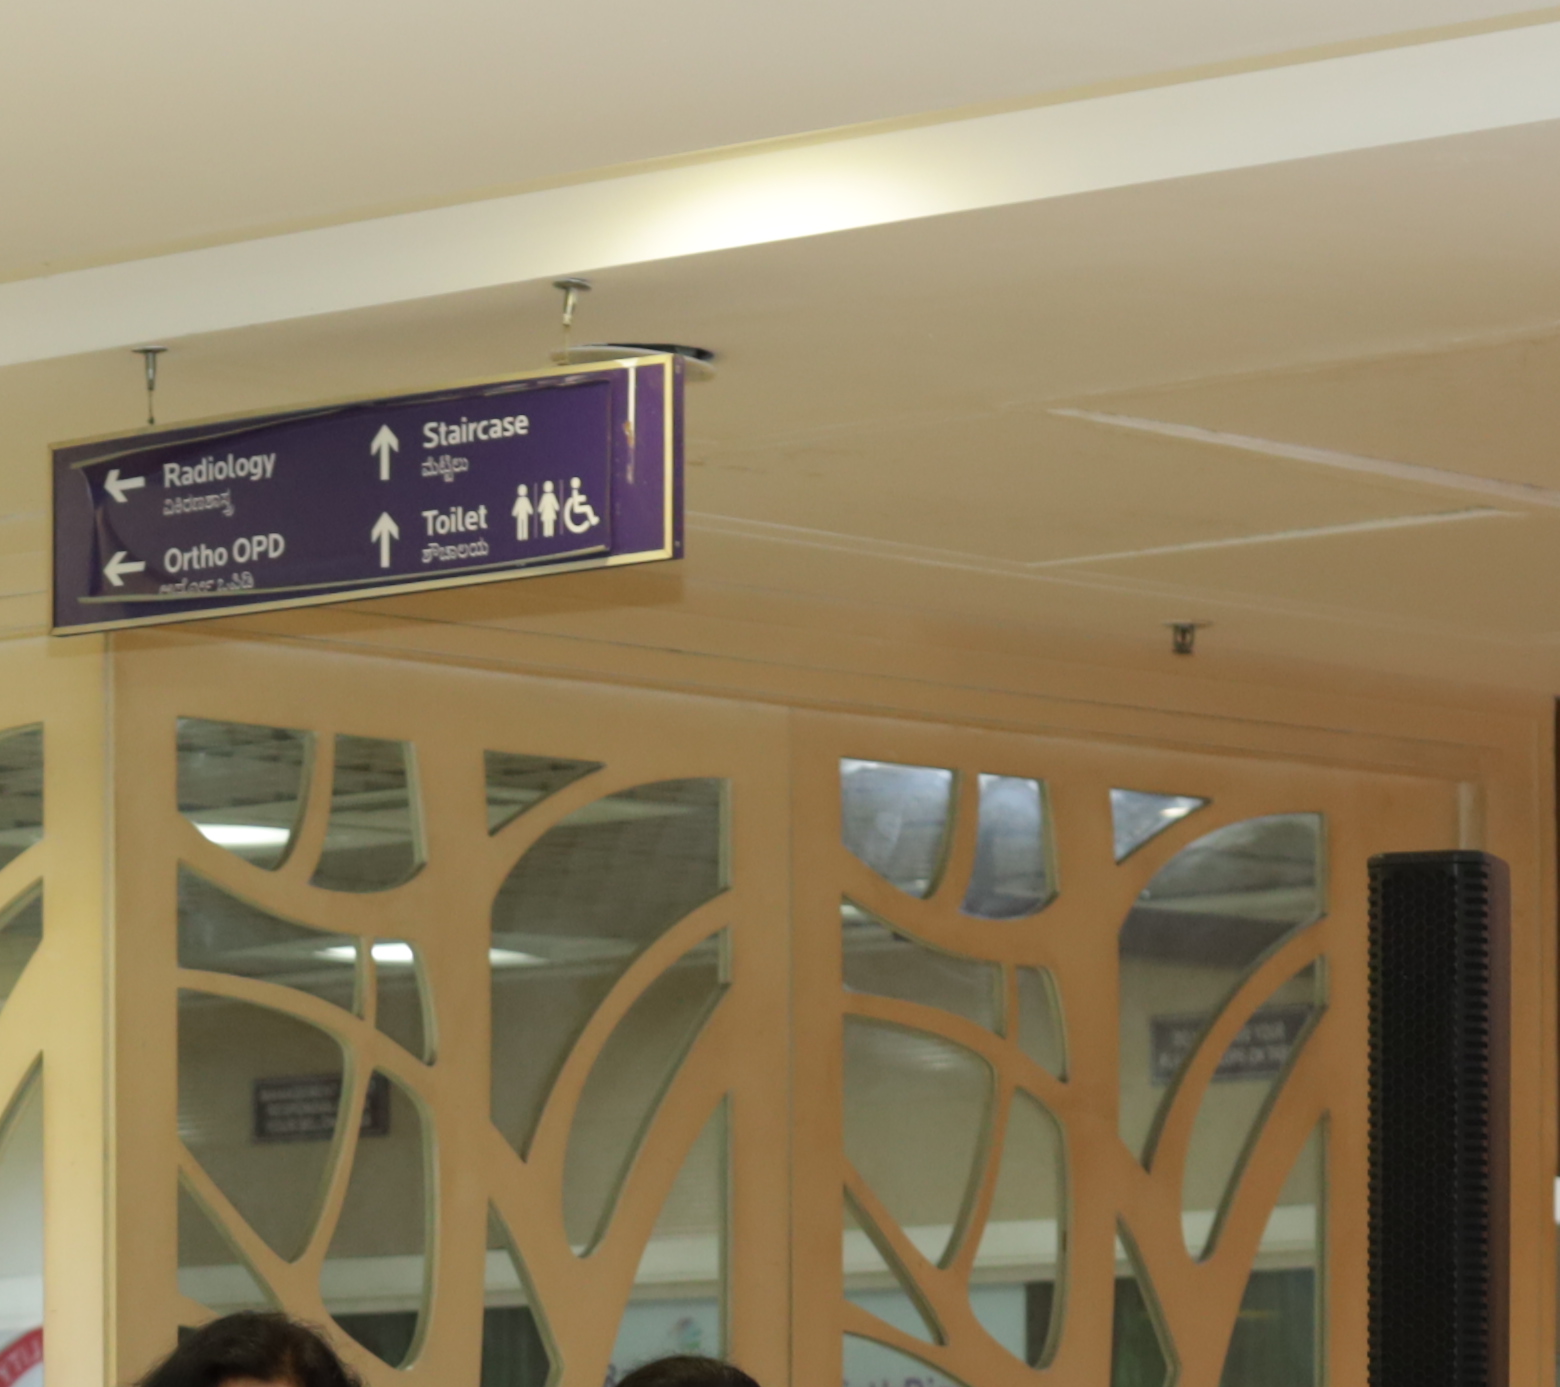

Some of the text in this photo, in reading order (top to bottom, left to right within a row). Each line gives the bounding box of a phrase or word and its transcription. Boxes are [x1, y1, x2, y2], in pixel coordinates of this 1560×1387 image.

[423, 414, 529, 448] Staircase
[163, 452, 276, 488] Radiology
[421, 504, 488, 536] Toilet
[164, 532, 285, 573] Ortho OPD
